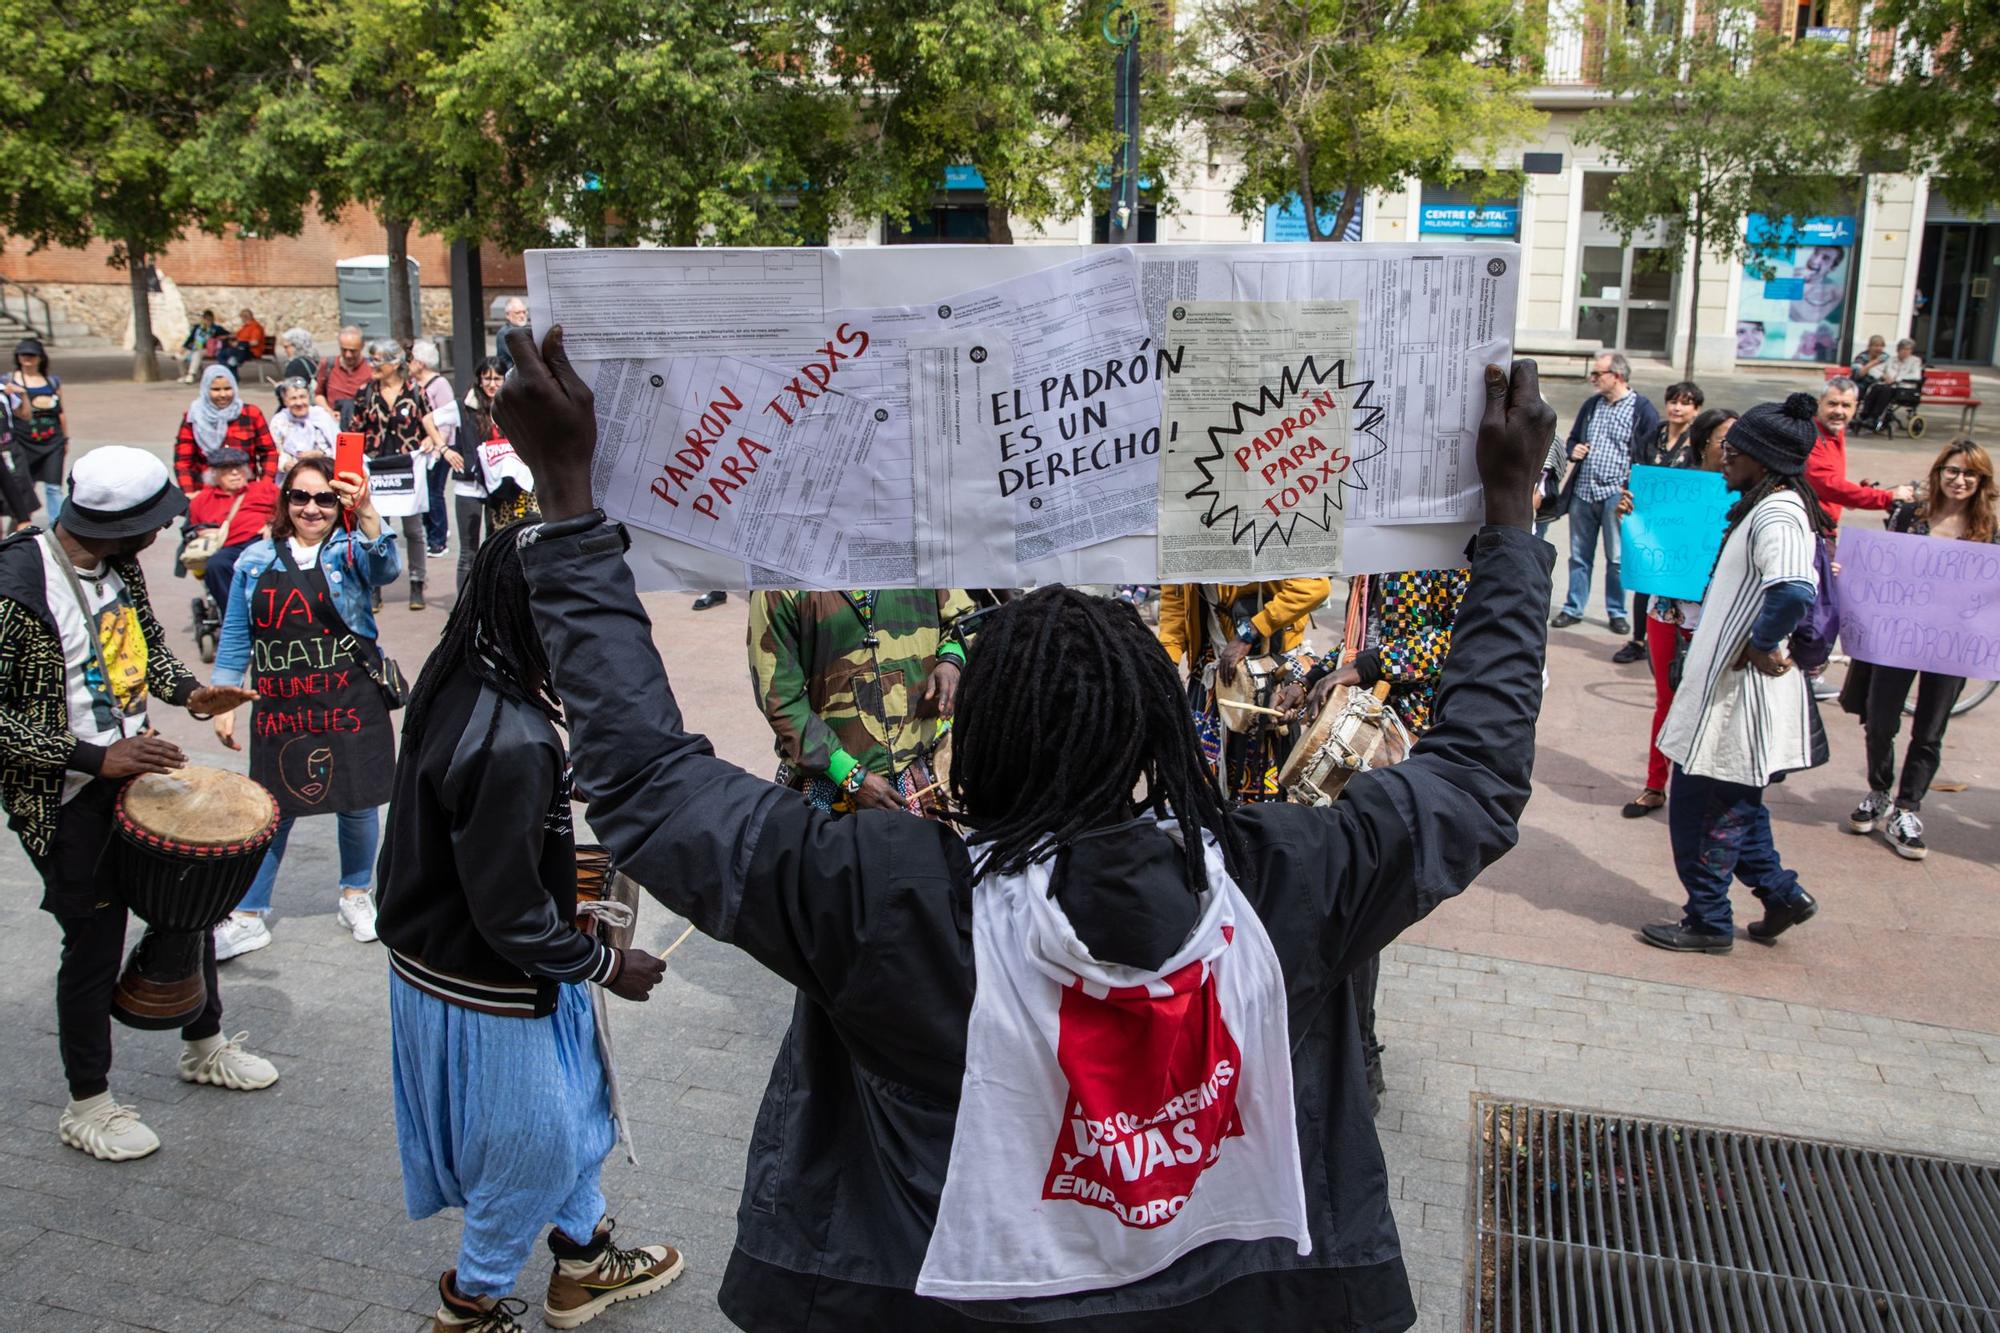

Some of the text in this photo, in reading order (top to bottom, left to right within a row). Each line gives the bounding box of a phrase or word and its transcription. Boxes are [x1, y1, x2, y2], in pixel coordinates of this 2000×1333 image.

[1425, 210, 1508, 220] CENTRE DNTAL
[991, 390, 1032, 426] EL
[1040, 338, 1185, 412] PADRÓN
[692, 436, 772, 520] PARA
[762, 322, 870, 426] TXDXS
[1000, 401, 1107, 462] ES UN
[1233, 389, 1338, 473] PADRÓN
[1260, 436, 1327, 486] PARA
[1912, 541, 2000, 582] QUEREMO
[1849, 579, 1935, 607] UNIDAS
[257, 670, 350, 699] REUNEIX
[1061, 1152, 1085, 1173] Y
[1070, 1117, 1203, 1183] VIVAS
